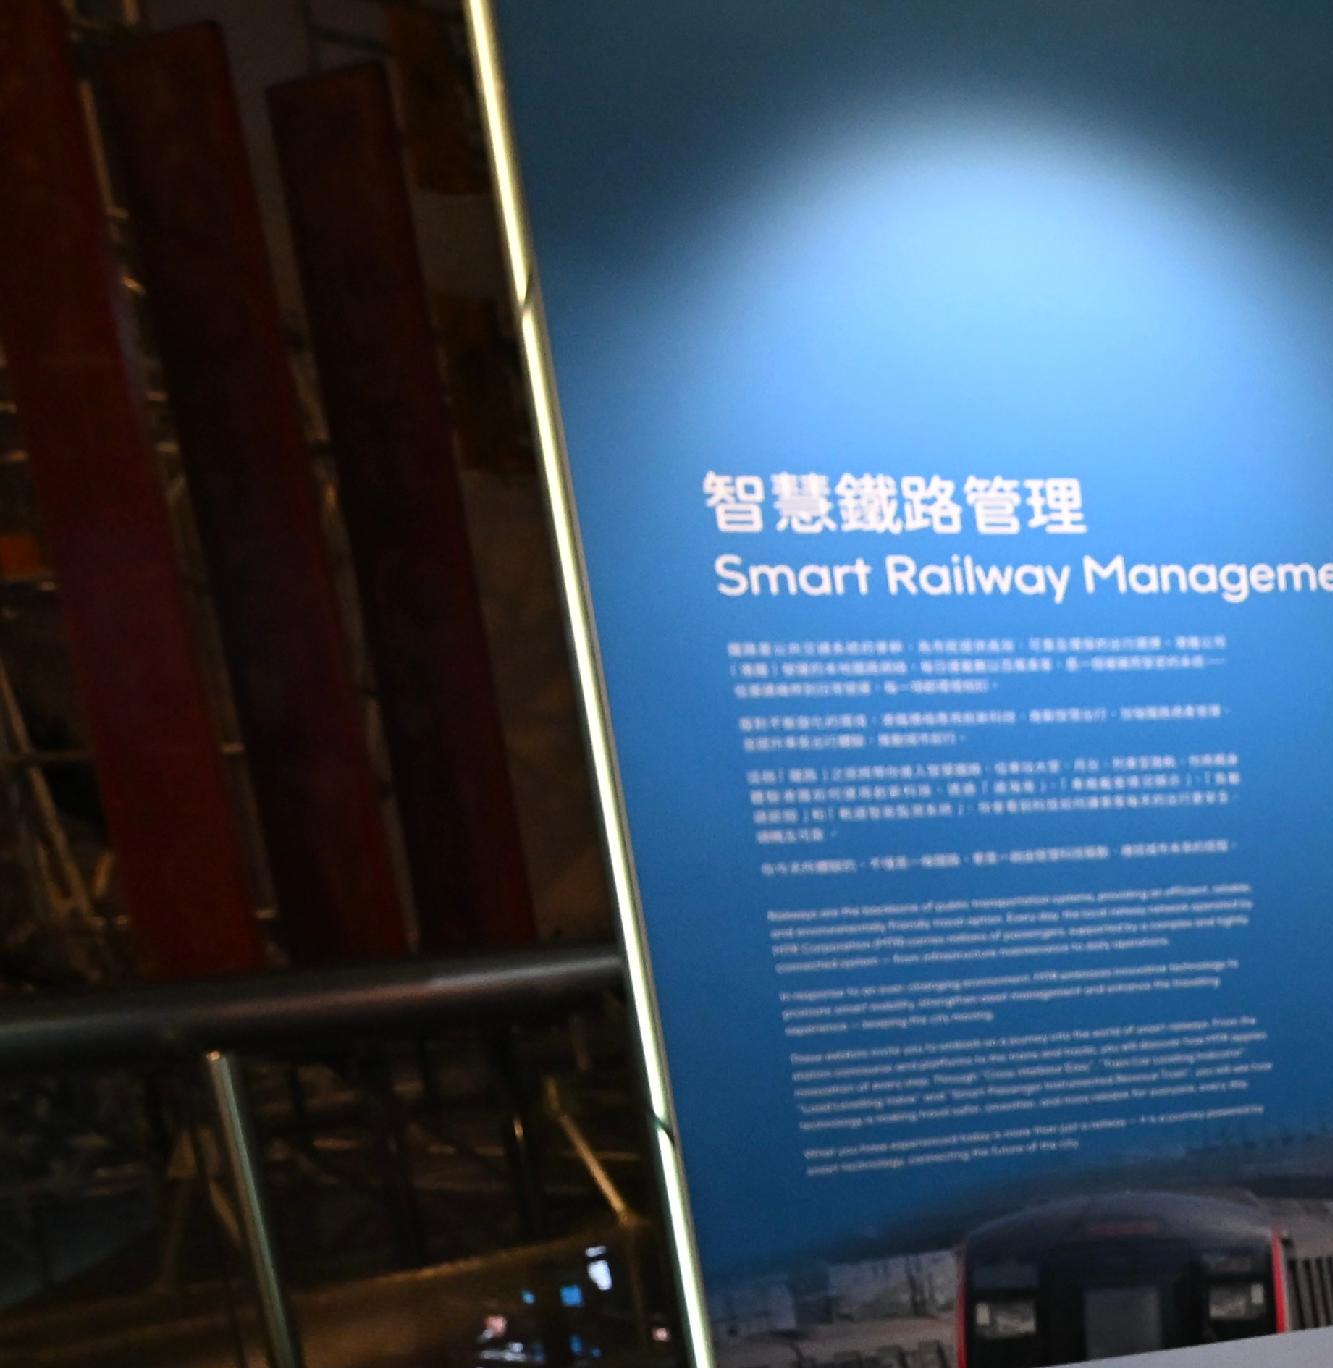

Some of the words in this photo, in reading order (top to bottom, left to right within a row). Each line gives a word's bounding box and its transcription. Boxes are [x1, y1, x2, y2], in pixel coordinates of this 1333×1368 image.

[703, 472, 1084, 533] 智慧鐵路管理
[714, 554, 870, 595] Smart
[884, 554, 1069, 602] Railway
